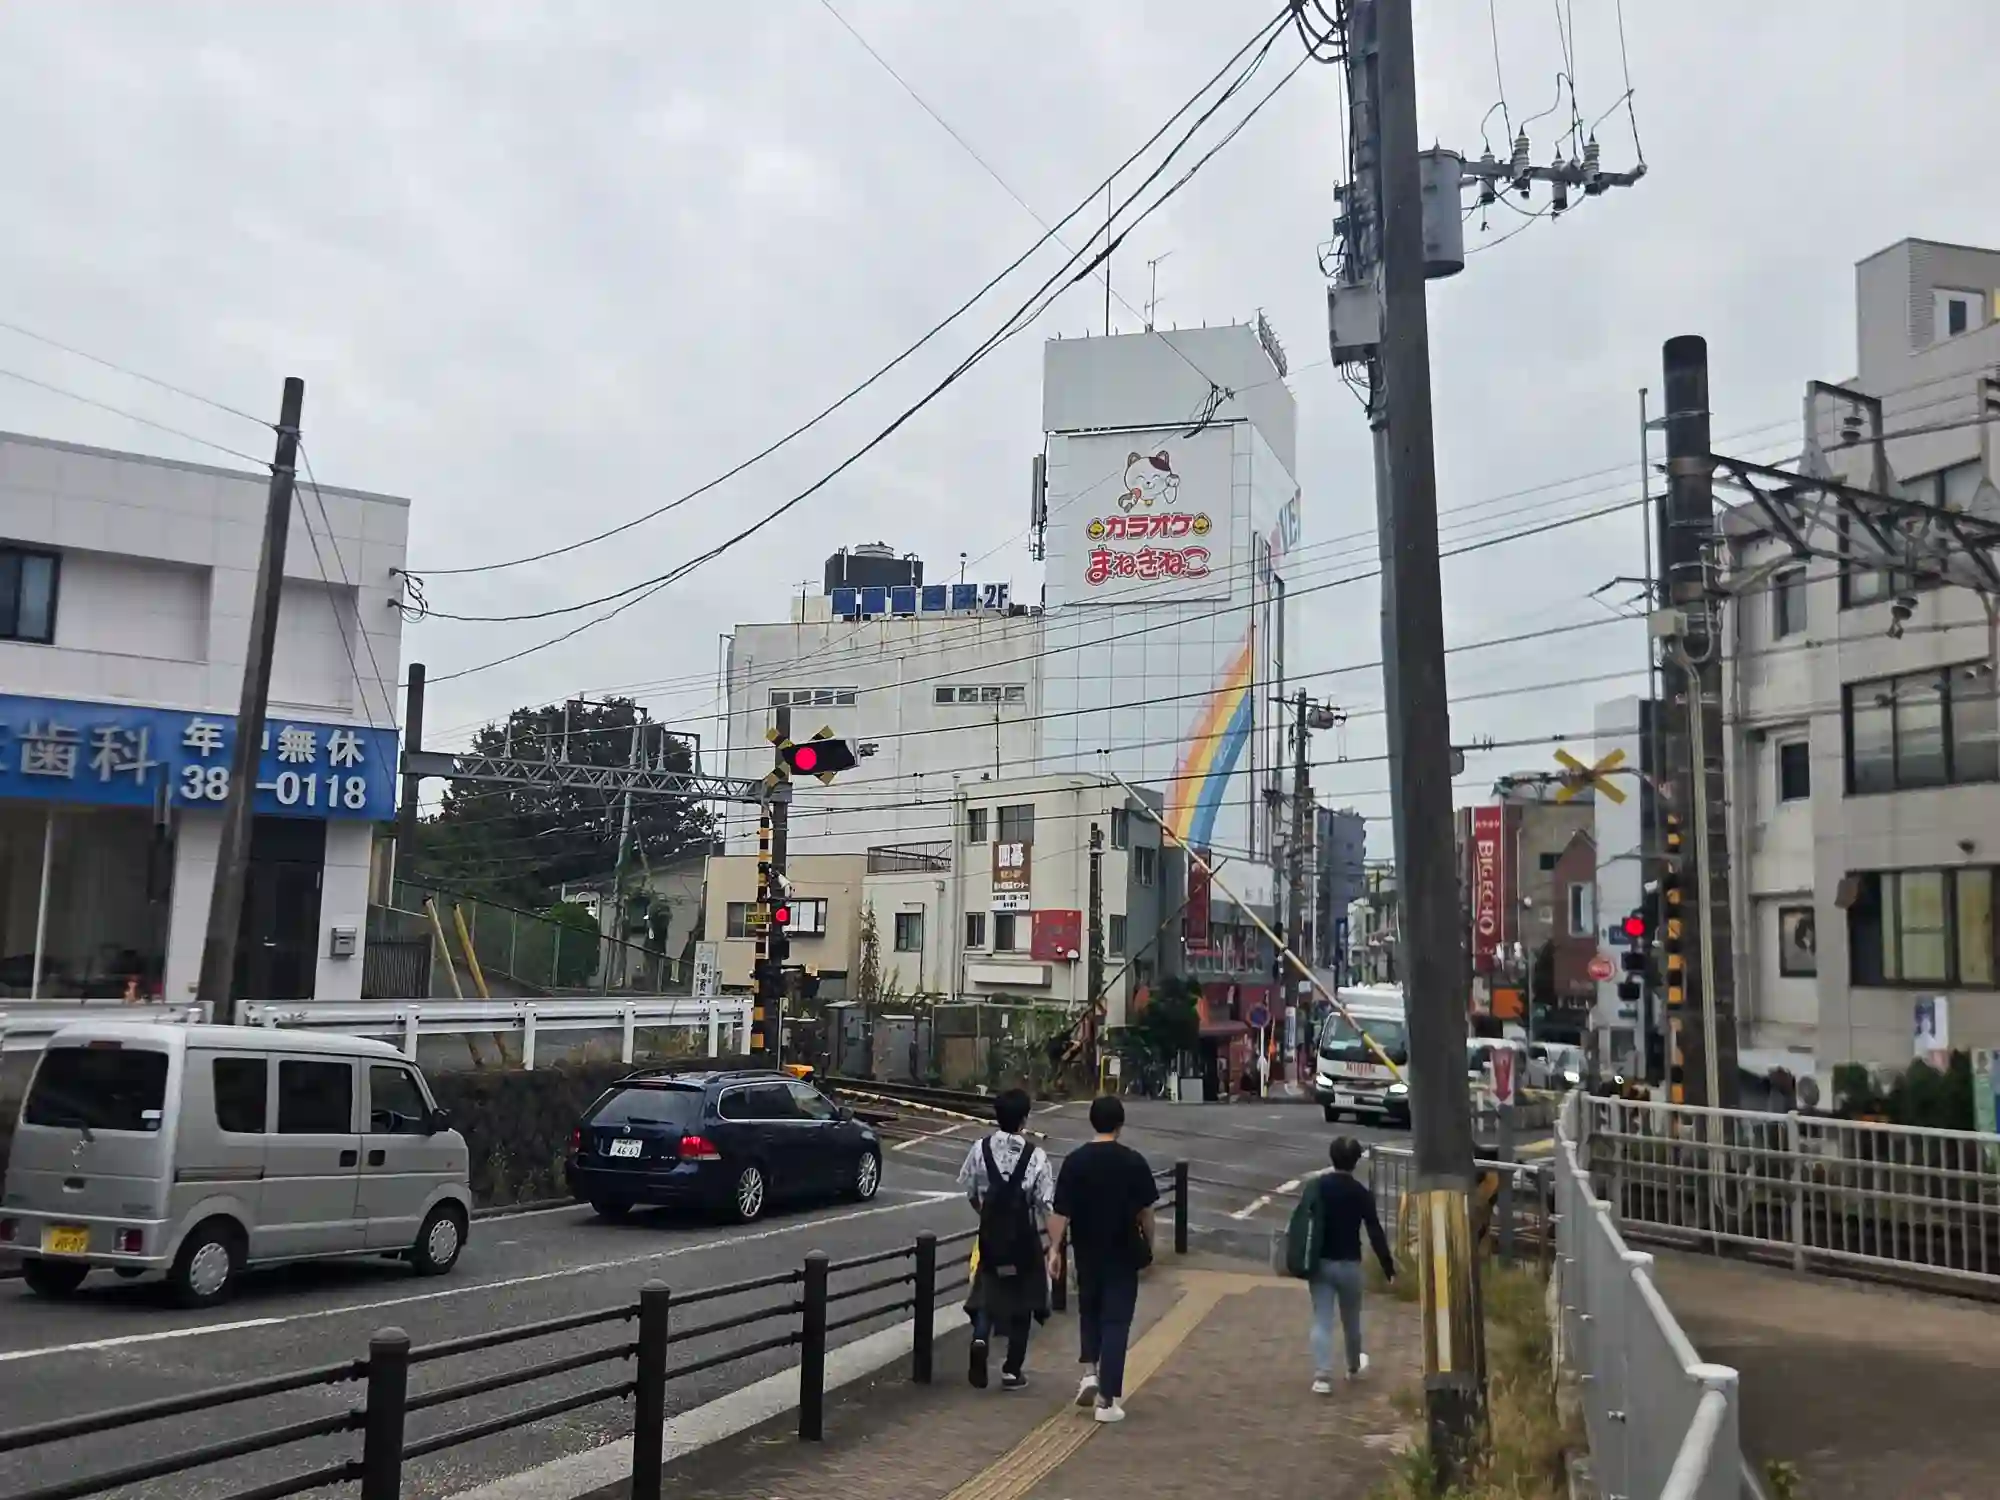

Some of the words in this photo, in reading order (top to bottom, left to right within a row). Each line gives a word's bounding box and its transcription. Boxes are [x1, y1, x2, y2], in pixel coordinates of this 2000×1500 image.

[1105, 513, 1194, 540] カラオケ
[1085, 545, 1210, 586] まねきねこ
[983, 584, 1010, 609] 2F
[0, 717, 158, 785] 歯科
[182, 717, 365, 768] 年無休
[180, 764, 366, 809] 38-0118
[1478, 840, 1494, 878] BIG
[1479, 880, 1494, 935] ECHO
